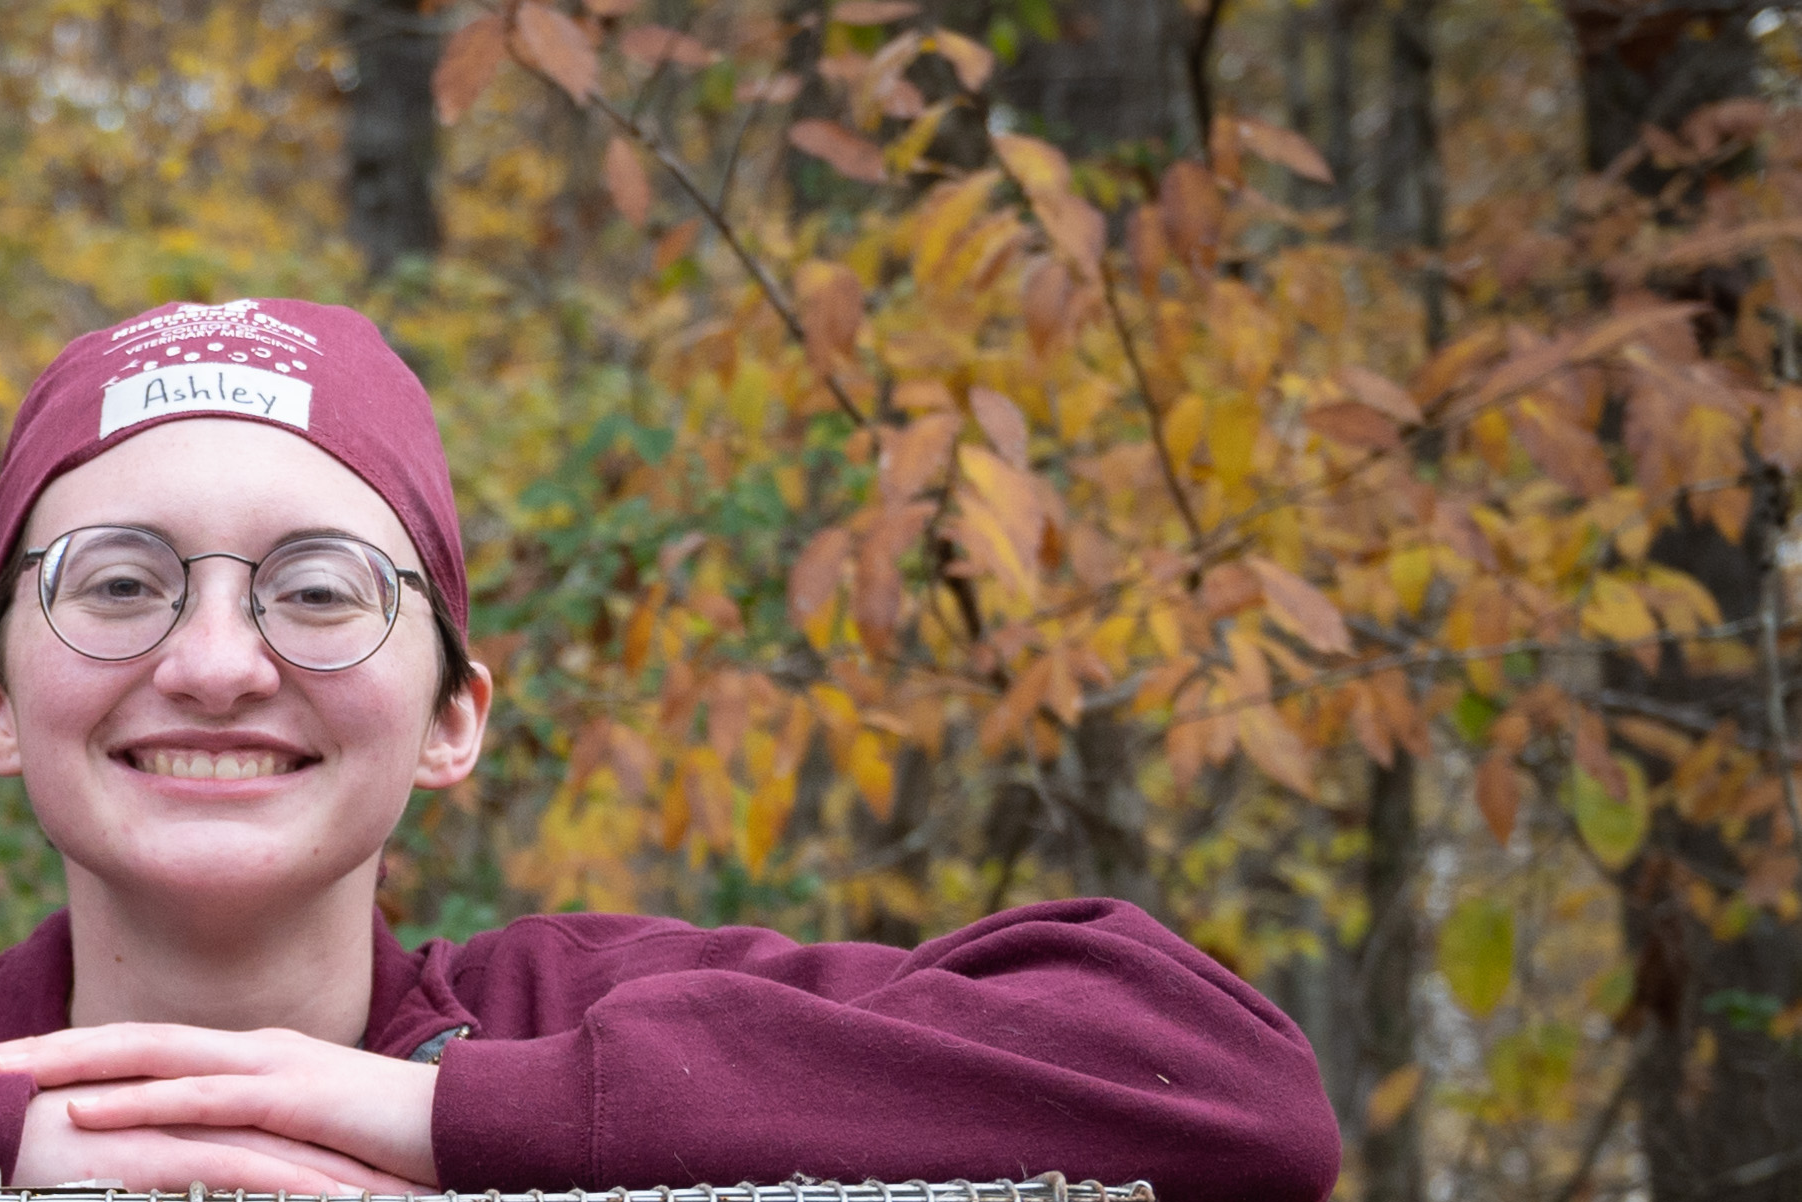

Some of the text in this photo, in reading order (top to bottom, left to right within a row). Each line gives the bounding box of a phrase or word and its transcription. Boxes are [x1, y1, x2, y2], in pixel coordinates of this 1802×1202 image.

[111, 310, 318, 346] MISSISSIPPI STATE
[125, 329, 298, 355] VETERINARY MEDICINE
[143, 371, 277, 414] Ashley
